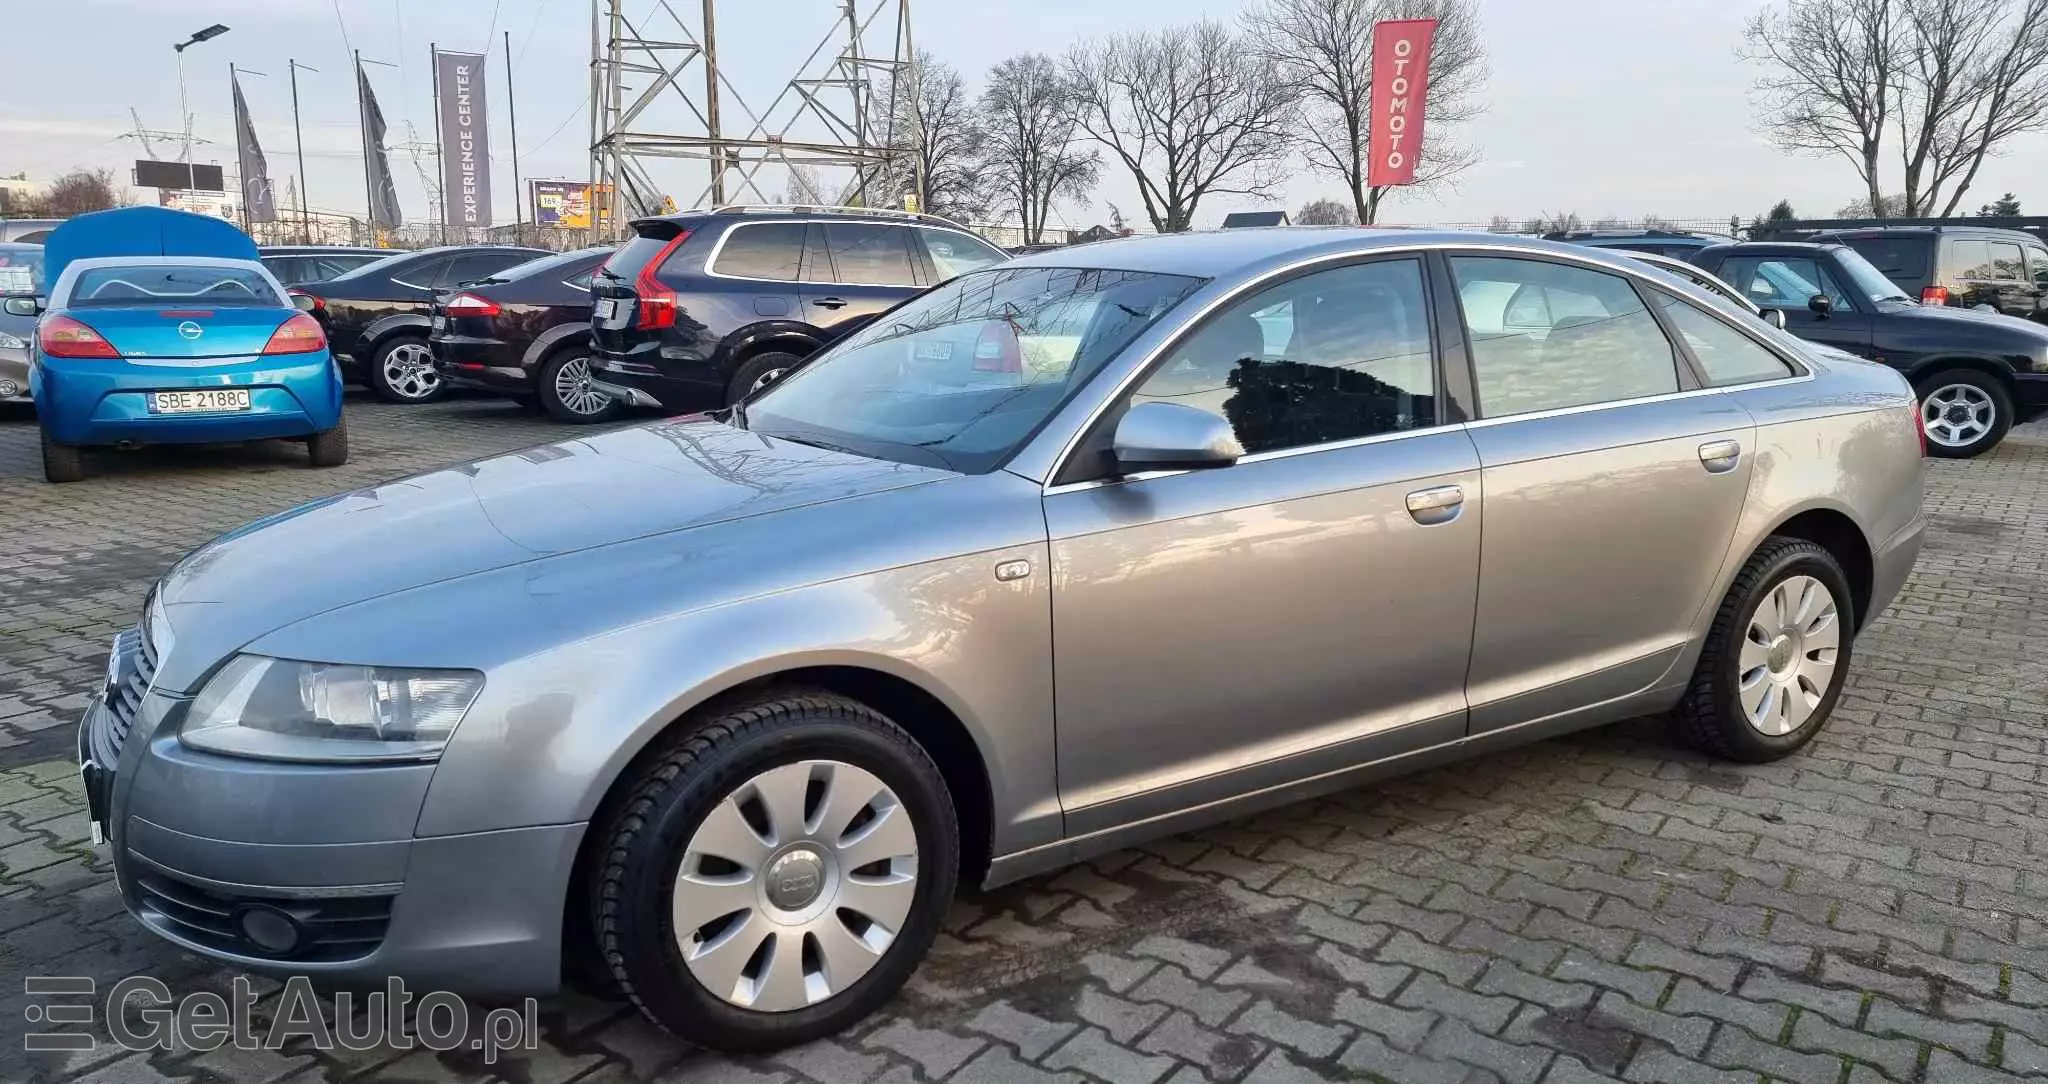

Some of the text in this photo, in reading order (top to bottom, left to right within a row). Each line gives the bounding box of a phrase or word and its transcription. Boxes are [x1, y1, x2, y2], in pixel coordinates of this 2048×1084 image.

[457, 65, 477, 221] EXPERIENCE CENTER
[1388, 39, 1411, 169] OTOMOTO
[158, 391, 248, 409] SBE 2188C
